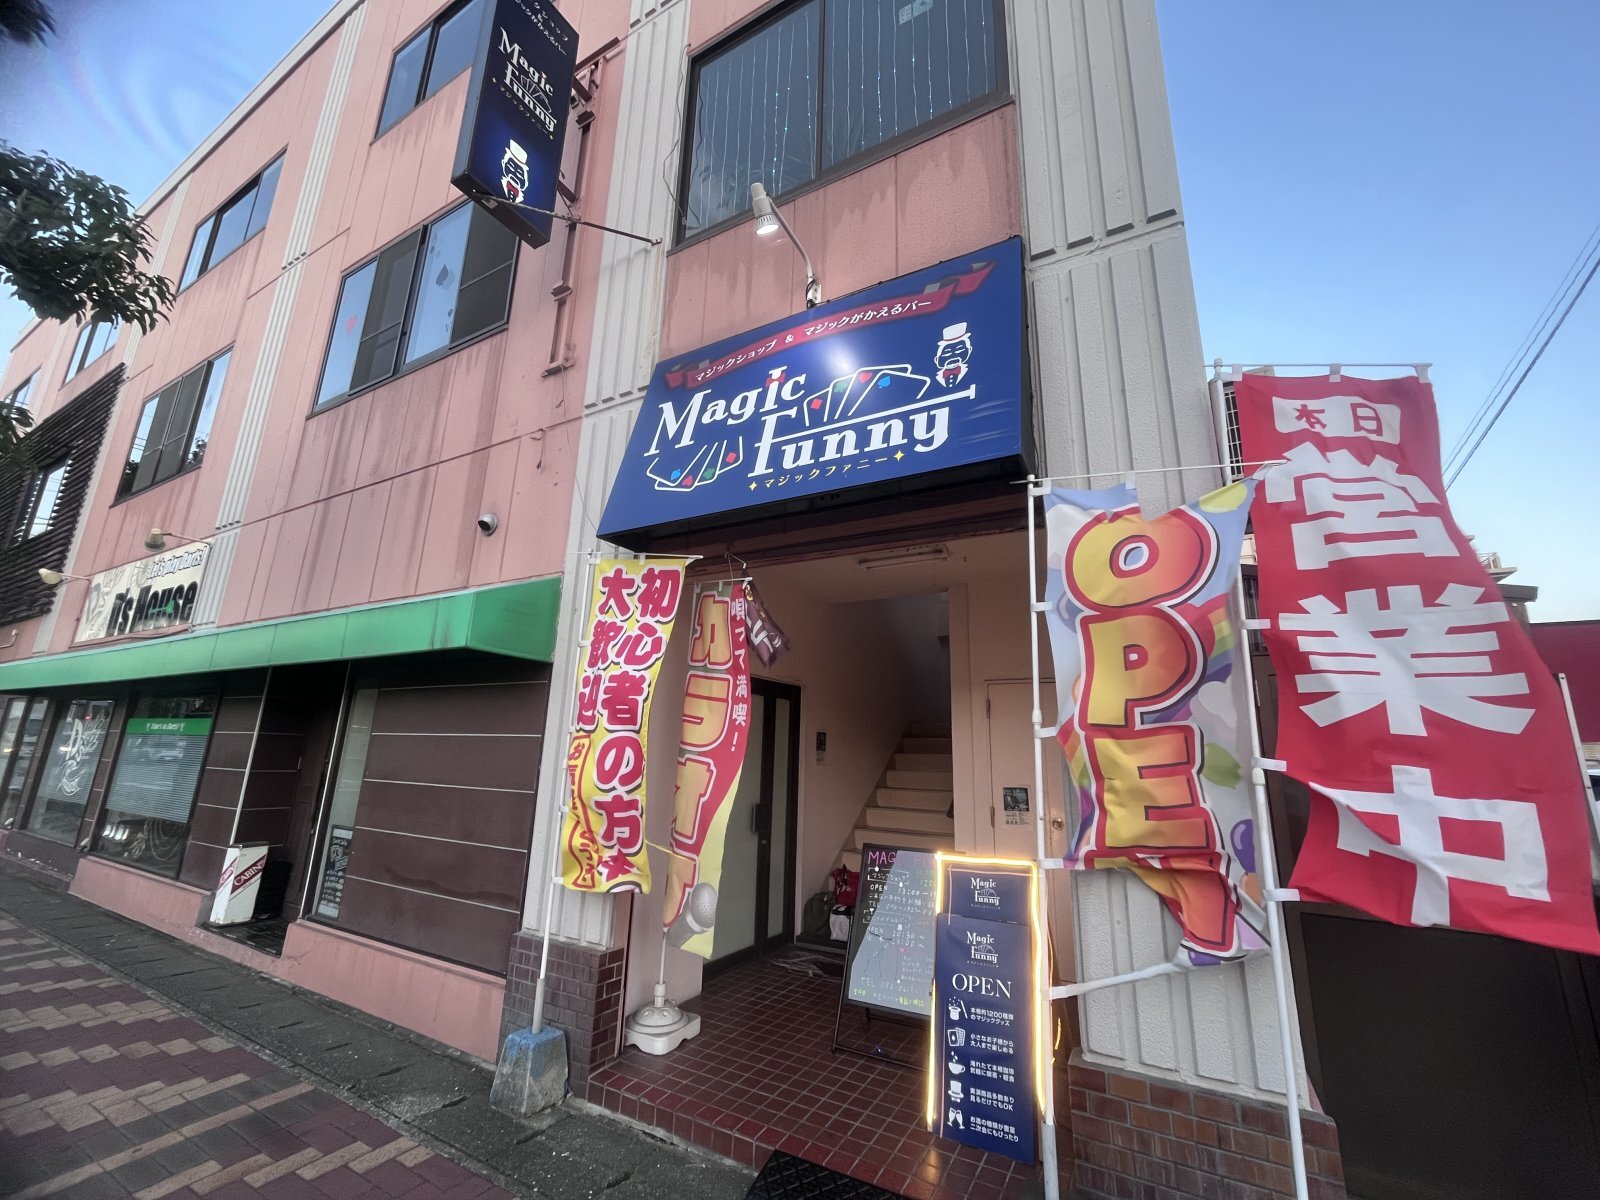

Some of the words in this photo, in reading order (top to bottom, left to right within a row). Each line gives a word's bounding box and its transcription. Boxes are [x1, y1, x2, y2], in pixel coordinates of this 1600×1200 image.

[499, 27, 554, 96] Magic
[504, 61, 558, 132] Funny
[695, 338, 778, 382] マジックショップ
[785, 334, 794, 344] &
[804, 300, 932, 336] マジックがかえるバー
[643, 365, 806, 457] Magic
[1294, 403, 1384, 437] 本日
[747, 385, 976, 478] Funny
[764, 457, 888, 489] マジックファニー
[128, 581, 198, 633] House
[1265, 441, 1551, 928] 営業中
[867, 851, 905, 865] MAG
[970, 877, 997, 889] Magic
[975, 890, 1000, 906] Funny
[966, 931, 995, 945] Magic
[971, 946, 998, 964] Funny
[952, 973, 1012, 999] OPEN
